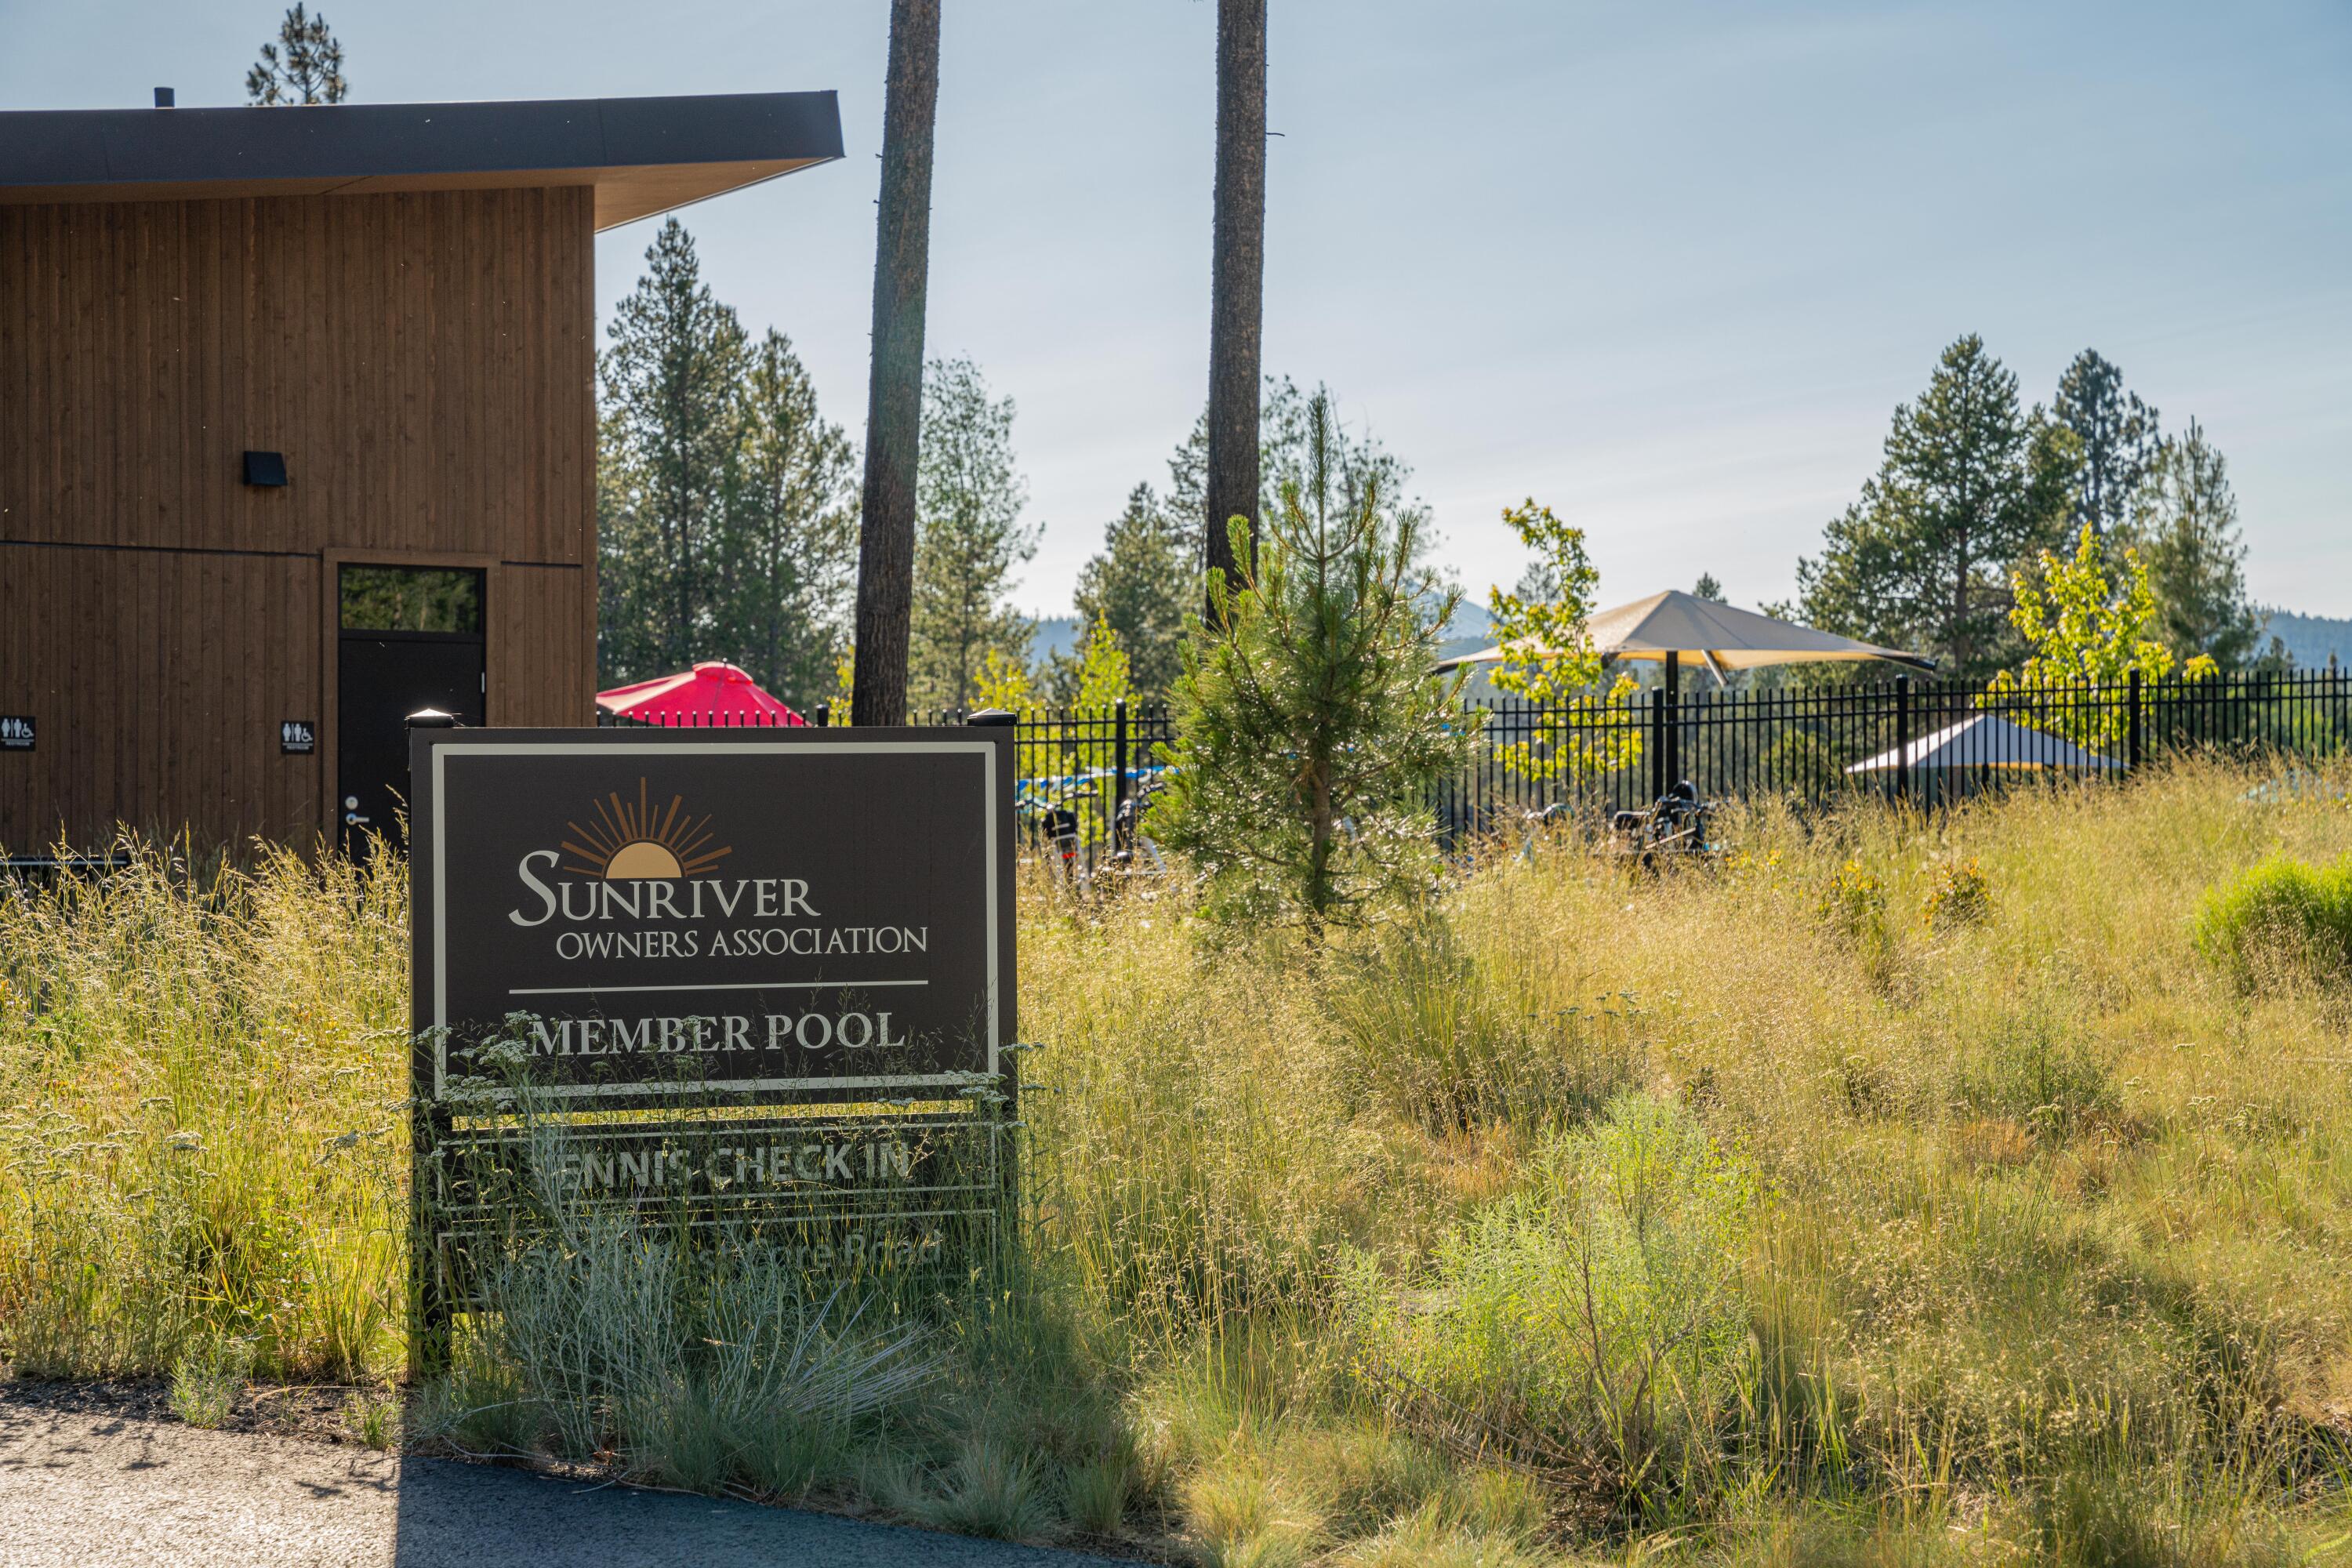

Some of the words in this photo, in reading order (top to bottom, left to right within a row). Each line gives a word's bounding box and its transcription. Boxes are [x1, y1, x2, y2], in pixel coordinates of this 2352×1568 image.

[556, 930, 699, 960] OWNERS
[708, 926, 928, 956] ASSOCIATION
[527, 1016, 755, 1056] MEMBER
[765, 1011, 906, 1048] POOL
[539, 1149, 692, 1191] ENNIS
[704, 1144, 853, 1183] CHECK
[866, 1142, 909, 1178] IN
